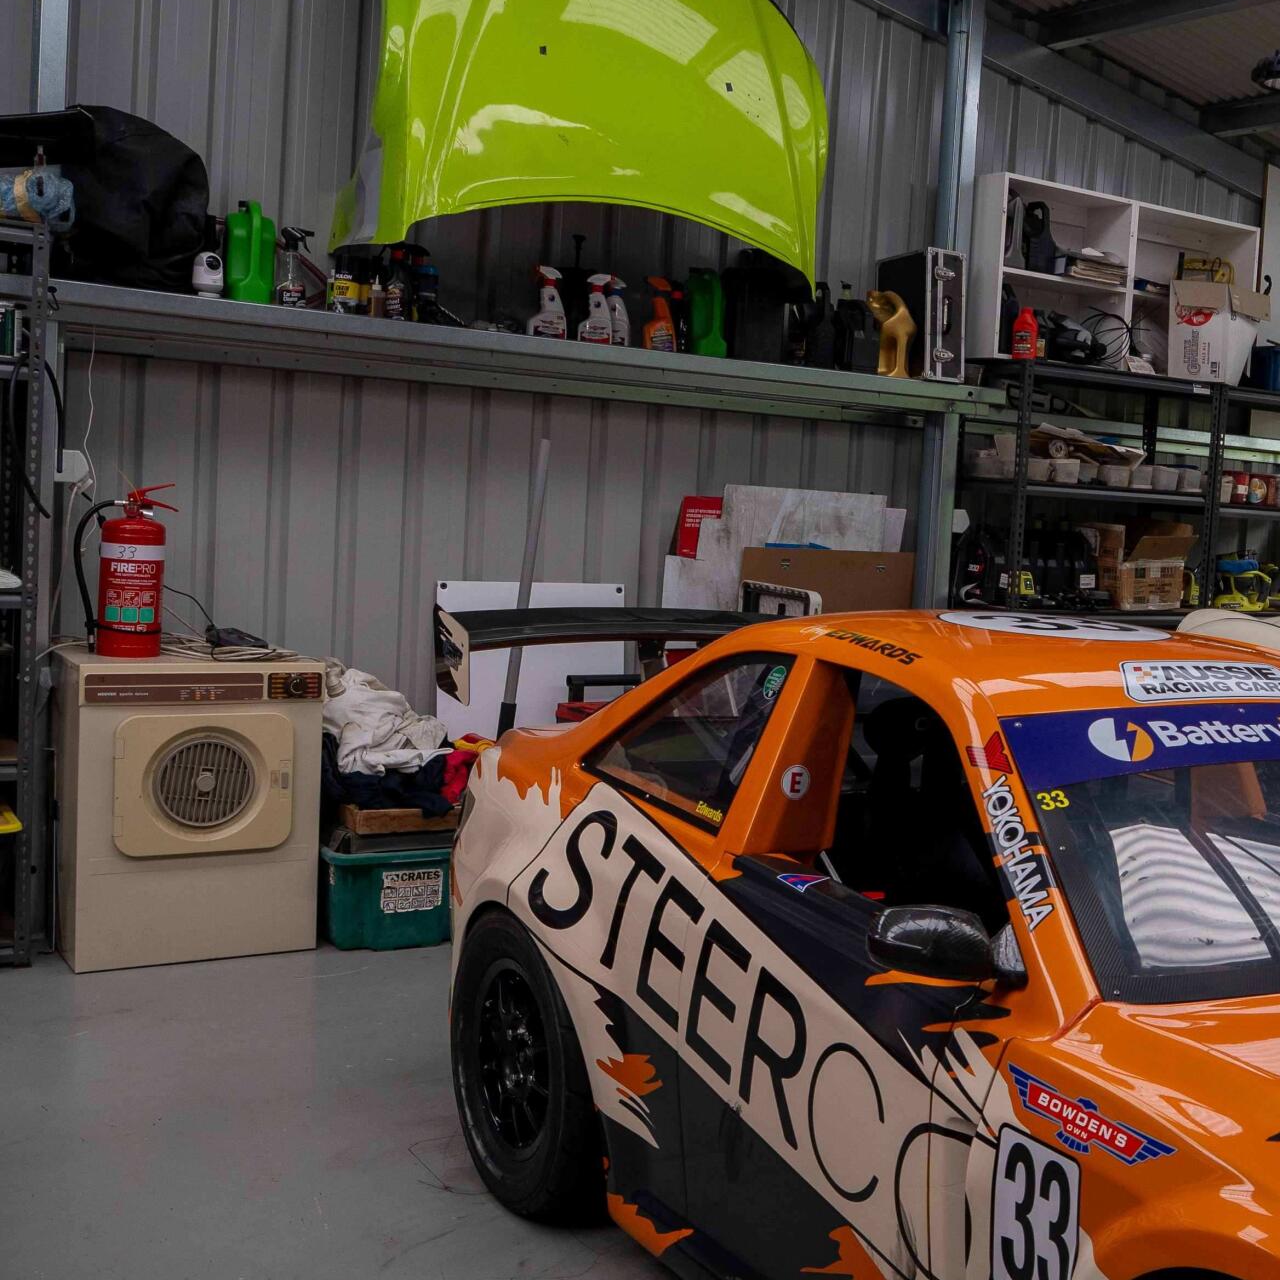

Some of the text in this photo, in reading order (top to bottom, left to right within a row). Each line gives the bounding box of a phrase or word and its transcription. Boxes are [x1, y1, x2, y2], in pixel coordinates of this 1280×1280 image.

[117, 545, 137, 559] 33
[110, 562, 156, 575] FIREPRO
[825, 629, 924, 666] EDWARDS
[1141, 680, 1235, 696] RACING
[789, 772, 803, 794] E
[1036, 789, 1070, 811] 33
[695, 800, 723, 823] Edwards
[982, 773, 1055, 933] YOKOHAMA
[400, 870, 441, 882] CRATES
[1037, 1091, 1129, 1149] BOWDEN'S
[1066, 1123, 1088, 1140] OWN
